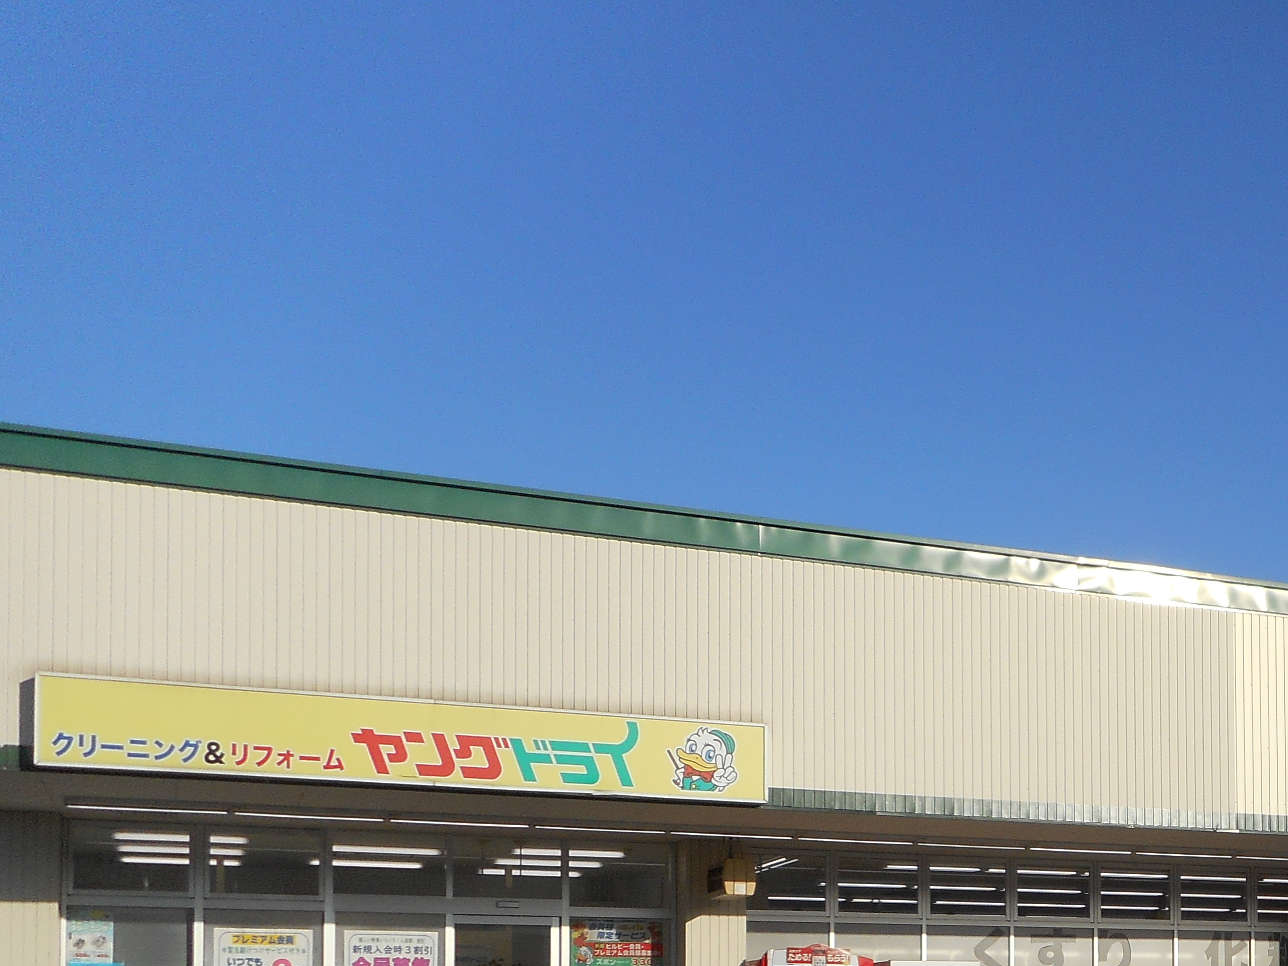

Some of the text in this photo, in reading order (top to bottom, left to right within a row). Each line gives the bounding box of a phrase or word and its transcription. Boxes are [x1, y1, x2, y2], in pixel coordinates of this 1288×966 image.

[350, 720, 640, 788] ヤングドライ
